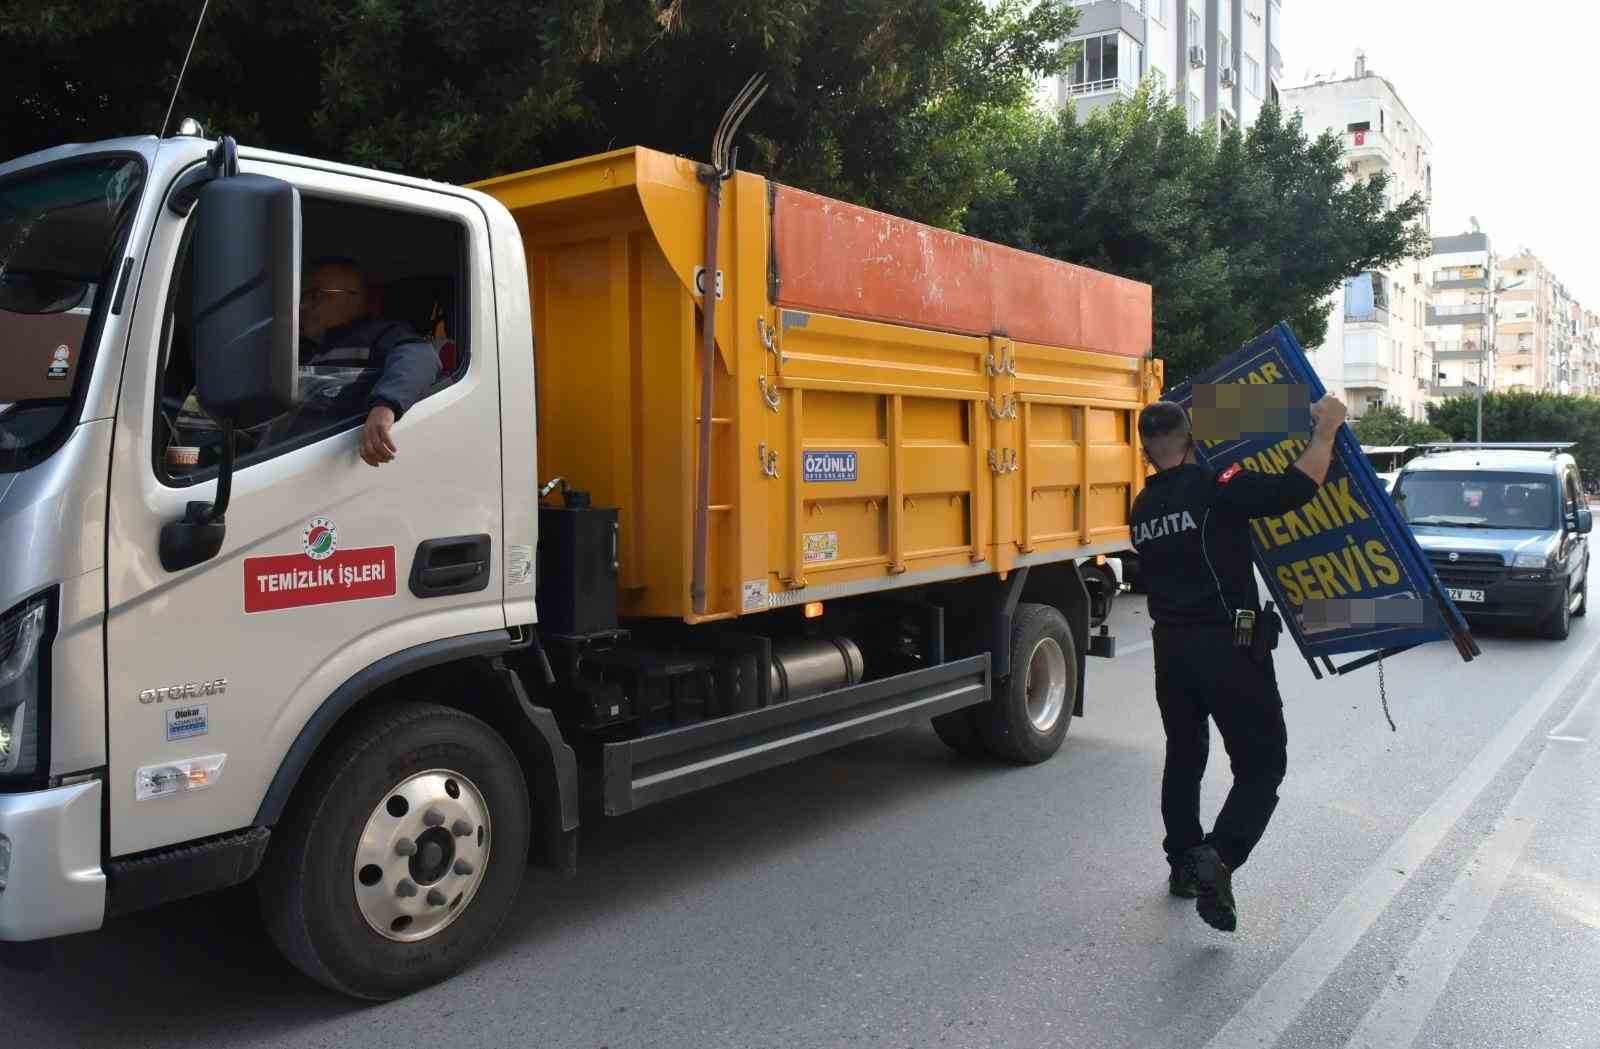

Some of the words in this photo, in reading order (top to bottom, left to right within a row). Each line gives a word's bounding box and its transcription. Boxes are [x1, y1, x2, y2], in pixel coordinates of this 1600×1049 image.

[805, 454, 855, 473] ÖZÜNLÜ
[257, 565, 335, 593] TEMİZLİK
[339, 559, 386, 588] İŞLERİ
[1276, 534, 1400, 606] SERVİS
[138, 678, 228, 704] OTOKAR
